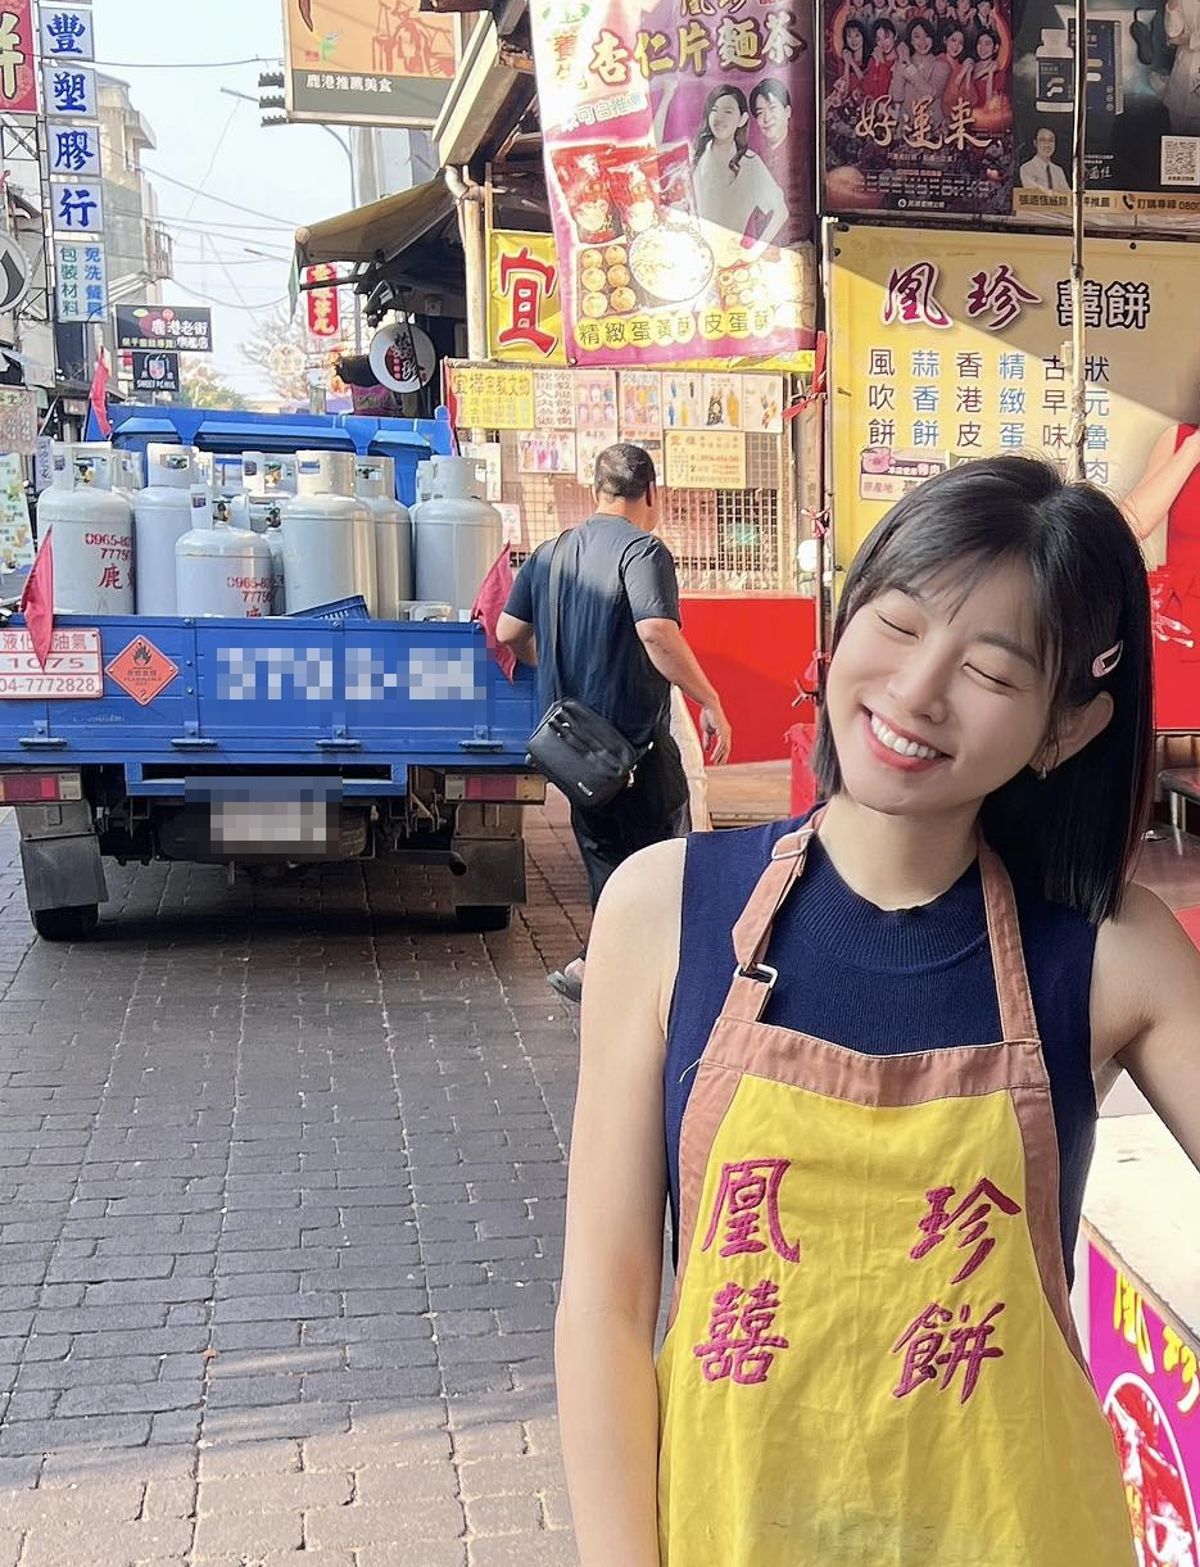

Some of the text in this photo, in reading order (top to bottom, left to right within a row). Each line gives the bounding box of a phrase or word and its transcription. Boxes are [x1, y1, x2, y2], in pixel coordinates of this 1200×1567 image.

[46, 14, 97, 227] 豐塑膠行
[855, 95, 993, 151] 好運來
[60, 246, 79, 316] 包裝材料
[500, 247, 557, 357] 宜
[884, 262, 1042, 330] 凰珍
[868, 349, 896, 447] 風吹餅
[912, 349, 940, 447] 蒜香餅
[955, 351, 984, 463] 香港皮
[999, 352, 1026, 449] 精緻蛋
[1042, 354, 1072, 466] 古早味
[3, 632, 87, 650] 液化油氣
